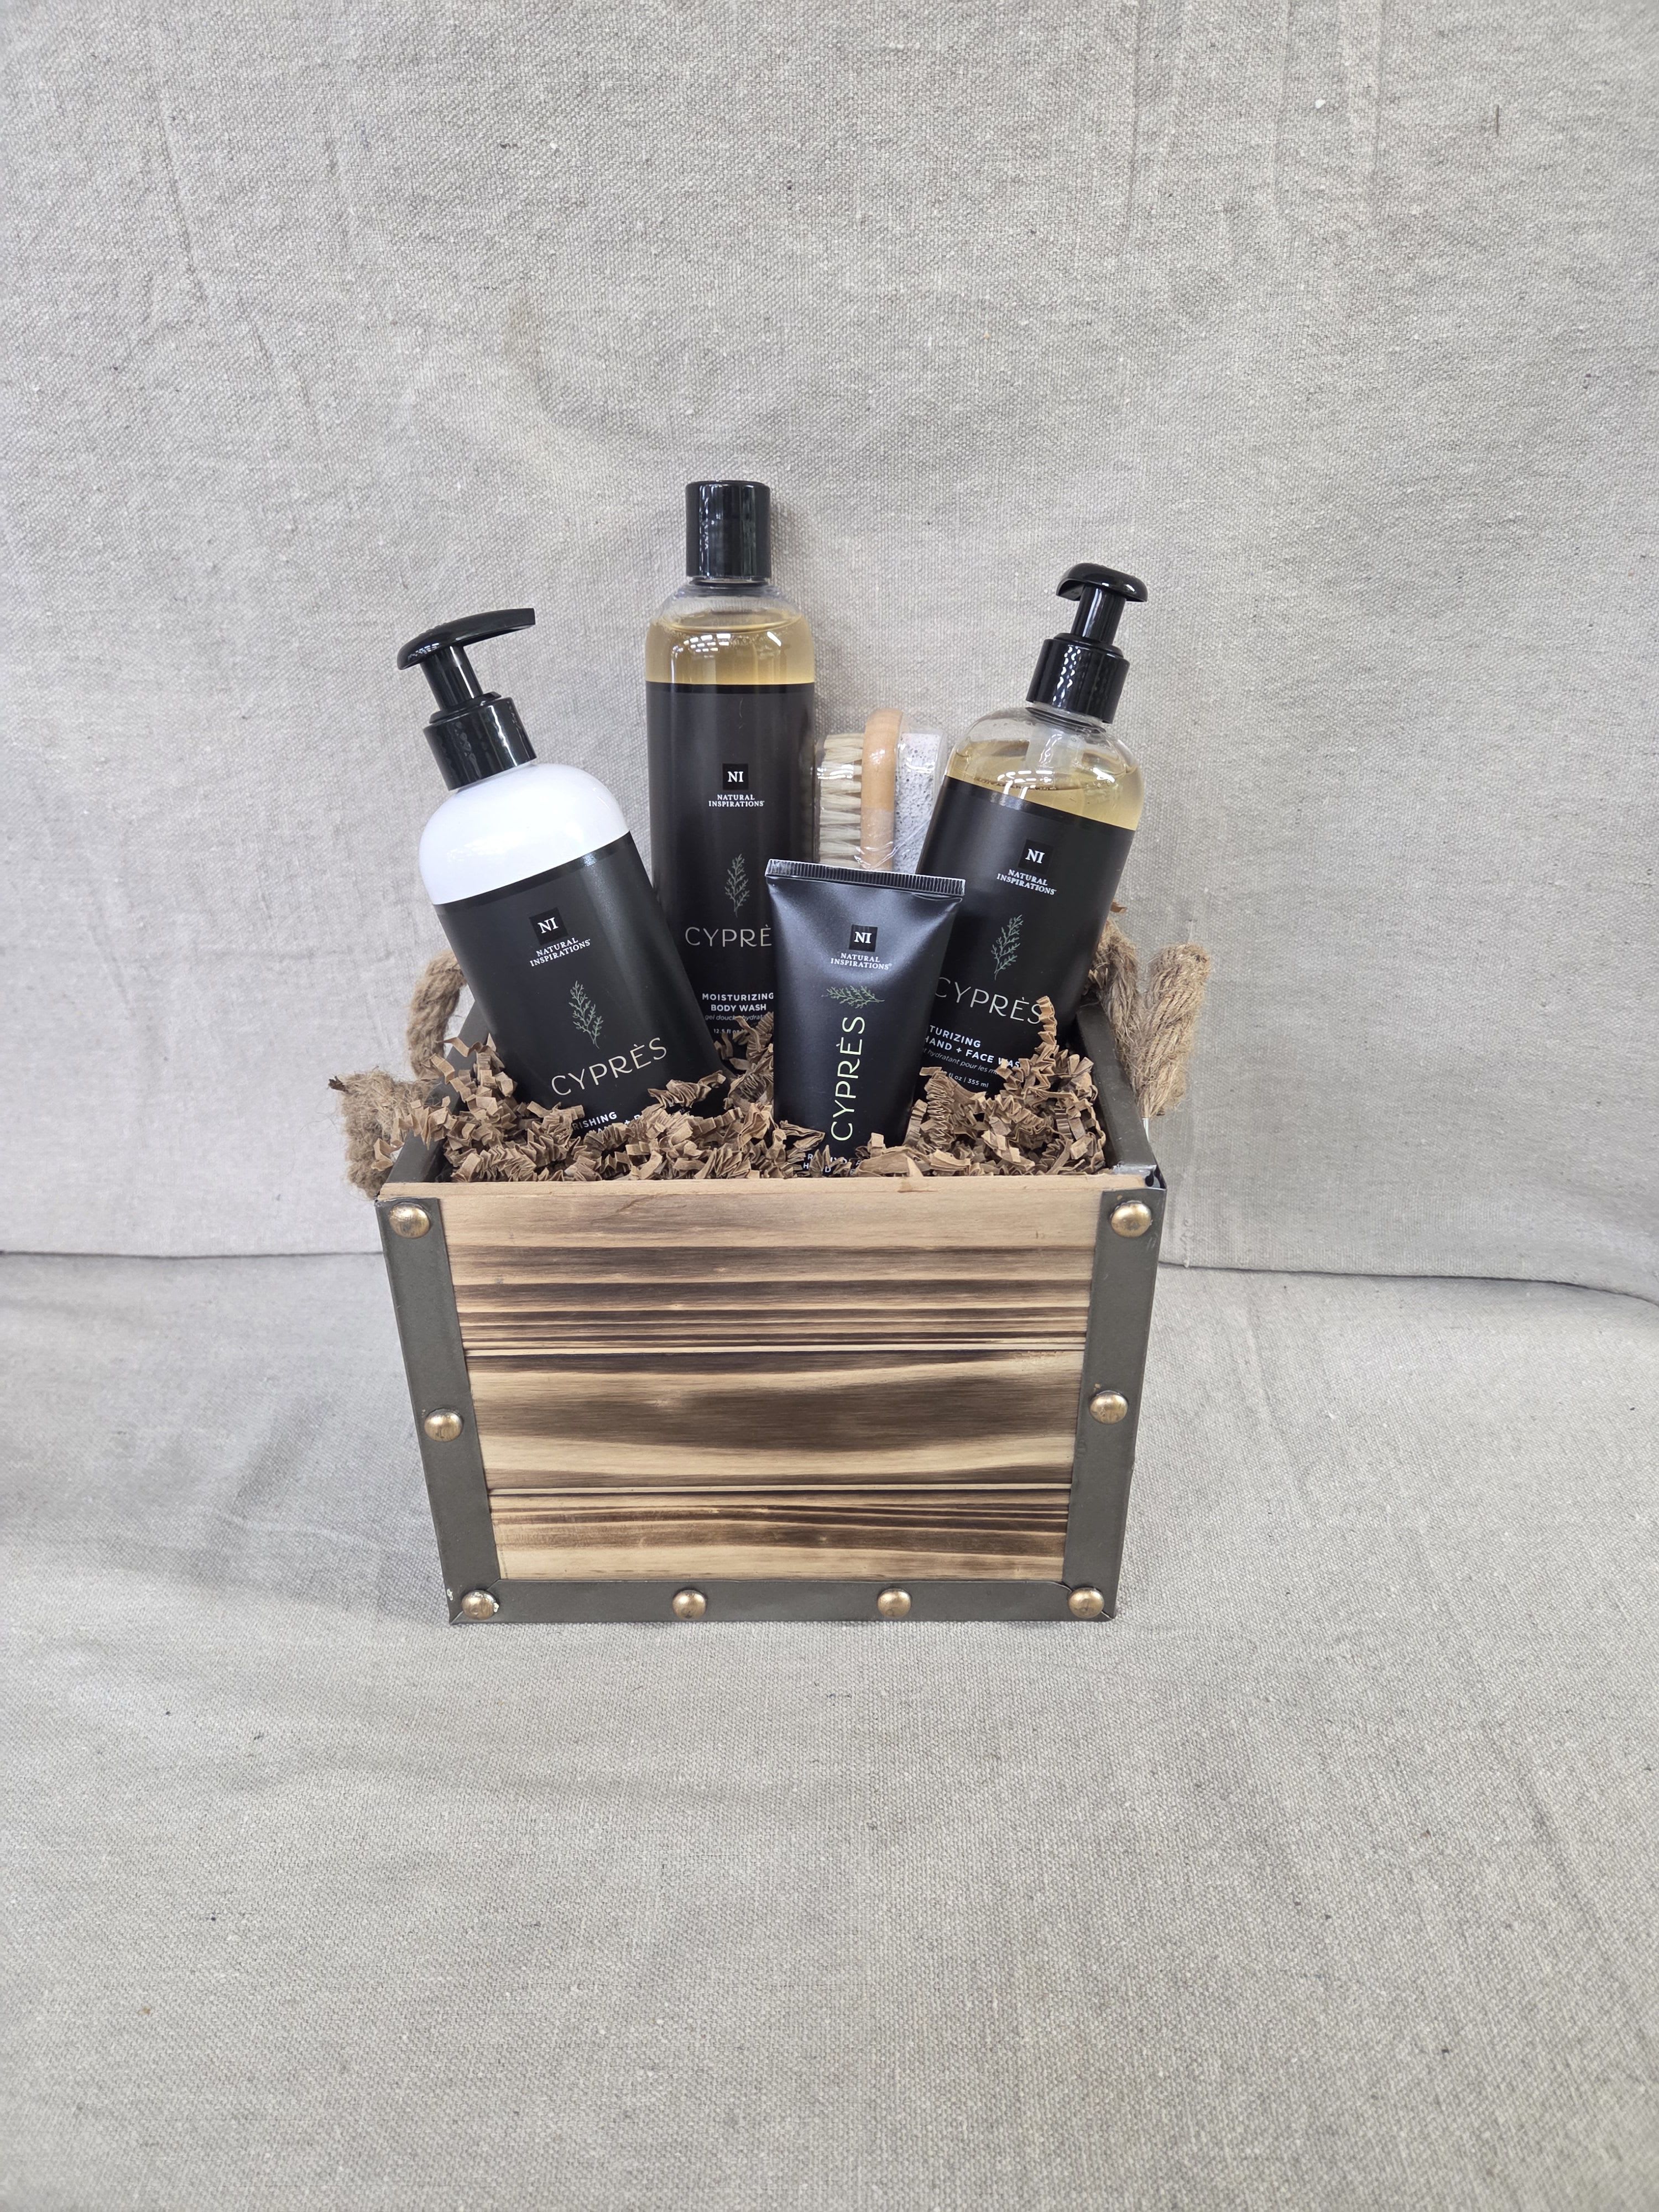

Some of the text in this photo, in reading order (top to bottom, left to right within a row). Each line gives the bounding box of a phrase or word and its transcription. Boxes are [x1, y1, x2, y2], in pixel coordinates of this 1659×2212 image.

[727, 771, 744, 782] NI
[1025, 848, 1045, 864] NI
[1008, 869, 1048, 886] NATURAL
[538, 917, 559, 933] NI
[685, 924, 773, 947] CYPRÈ
[854, 931, 872, 944] NI
[536, 937, 578, 957] NATURAL
[841, 952, 880, 963] NATURAL
[702, 993, 774, 1001] MOISTURIZING
[739, 1004, 766, 1012] WASH
[930, 1025, 981, 1048] TURIZING
[966, 1049, 994, 1063] FACE
[959, 1061, 978, 1070] pour
[978, 1065, 988, 1073] les
[572, 1112, 617, 1130] RISHING
